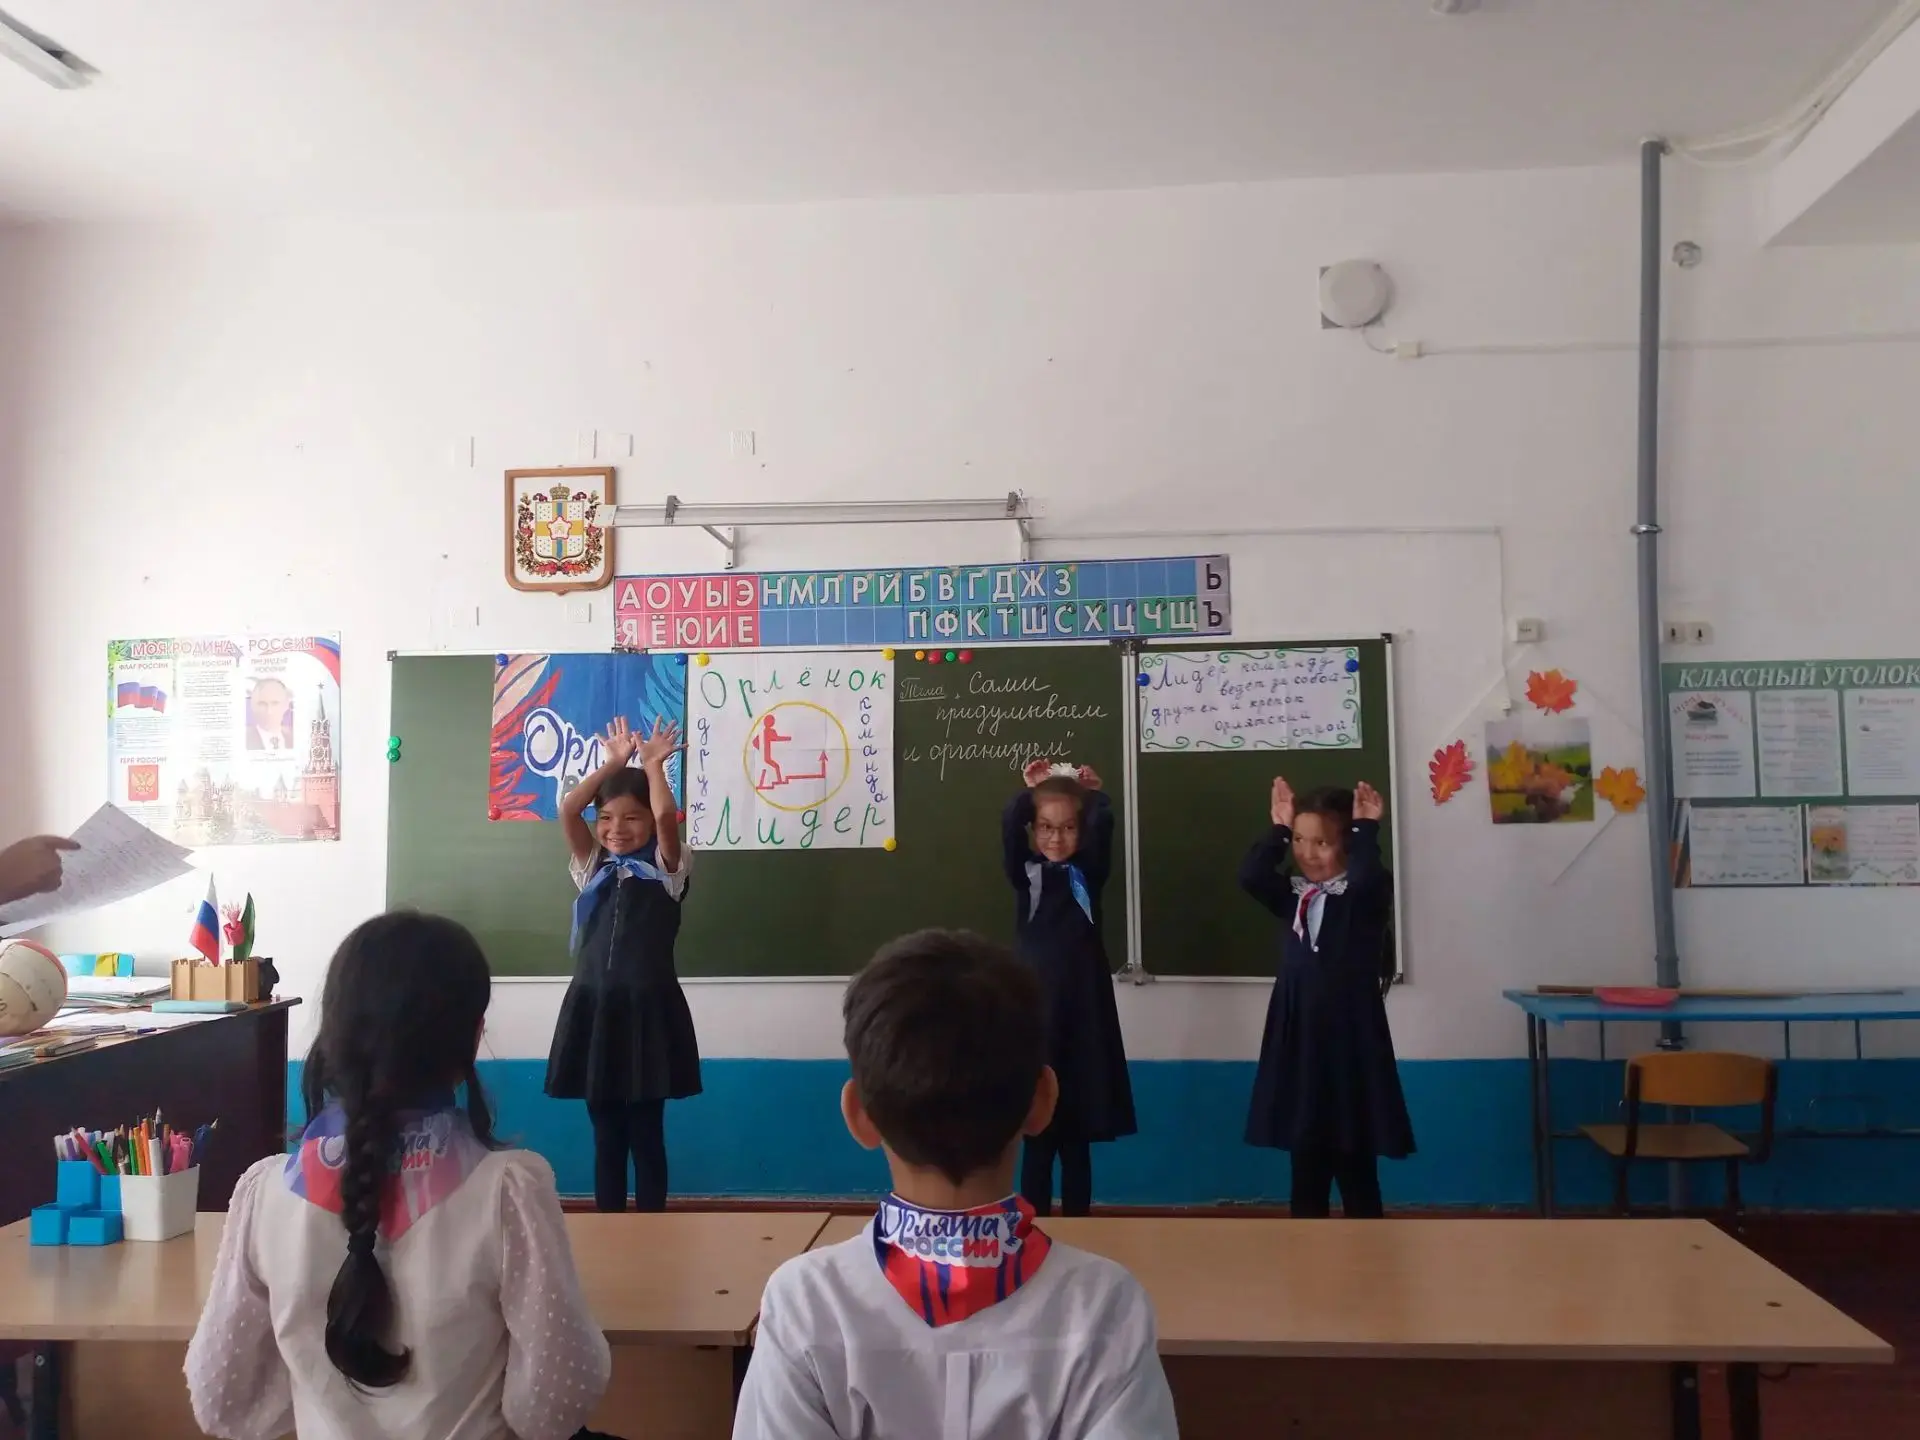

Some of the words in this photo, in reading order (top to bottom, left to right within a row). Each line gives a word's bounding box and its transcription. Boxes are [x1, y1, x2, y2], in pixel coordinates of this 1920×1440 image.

[132, 642, 167, 657] МОЯ
[172, 639, 234, 656] РОДИНА
[248, 636, 315, 652] РОССИЯ
[900, 677, 946, 699] Тема
[1152, 658, 1229, 693] Лидер
[1240, 657, 1334, 673] команду
[1678, 661, 1818, 688] КЛАССНЫЙ
[700, 668, 887, 719] Орлёнок
[1231, 702, 1240, 711] и
[1249, 694, 1305, 711] крепок
[936, 693, 1108, 738] придумываем
[903, 746, 920, 761] и
[706, 796, 886, 848] Лидер
